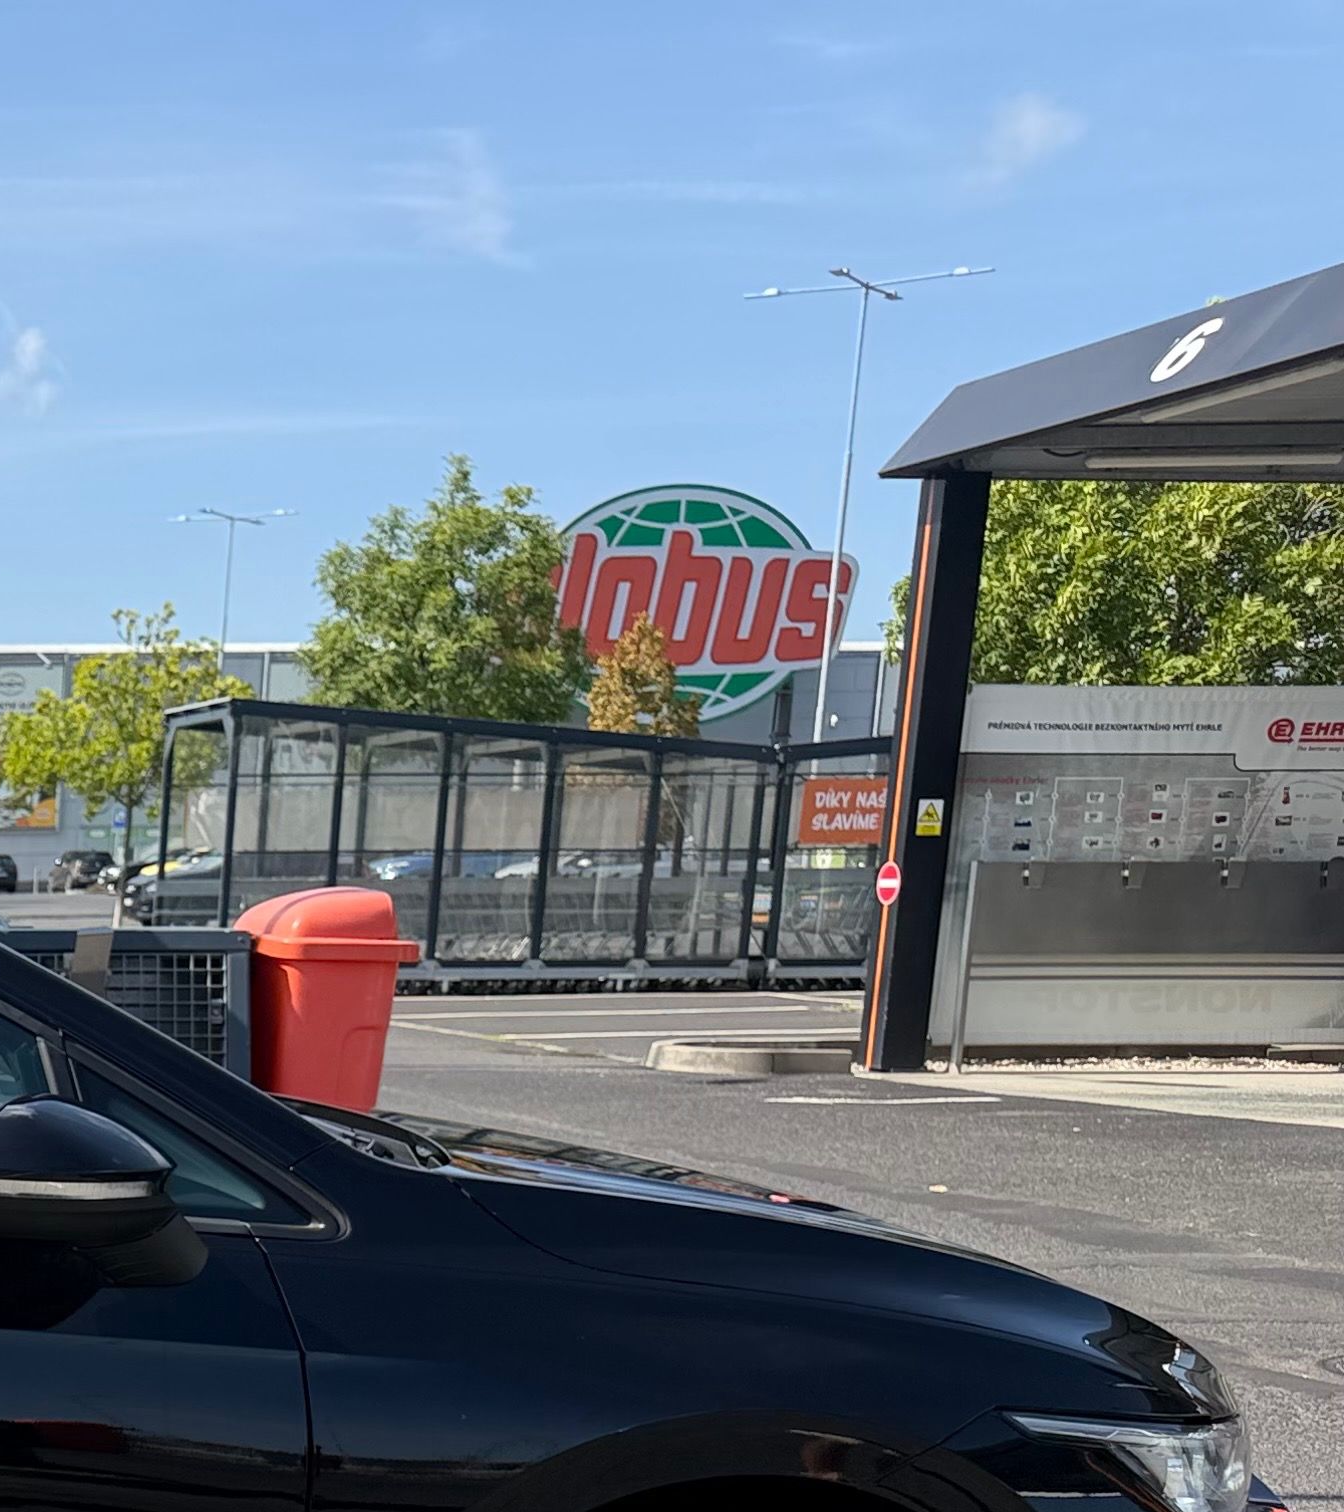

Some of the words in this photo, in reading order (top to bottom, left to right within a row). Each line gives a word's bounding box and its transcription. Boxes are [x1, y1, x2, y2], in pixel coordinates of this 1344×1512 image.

[1150, 317, 1223, 383] 6
[550, 530, 852, 666] lobus
[1033, 721, 1093, 731] TECHNOLOGIE
[1195, 722, 1223, 731] EHRLE
[815, 787, 851, 809] DÍKY
[811, 811, 880, 831] SLAVÍME
